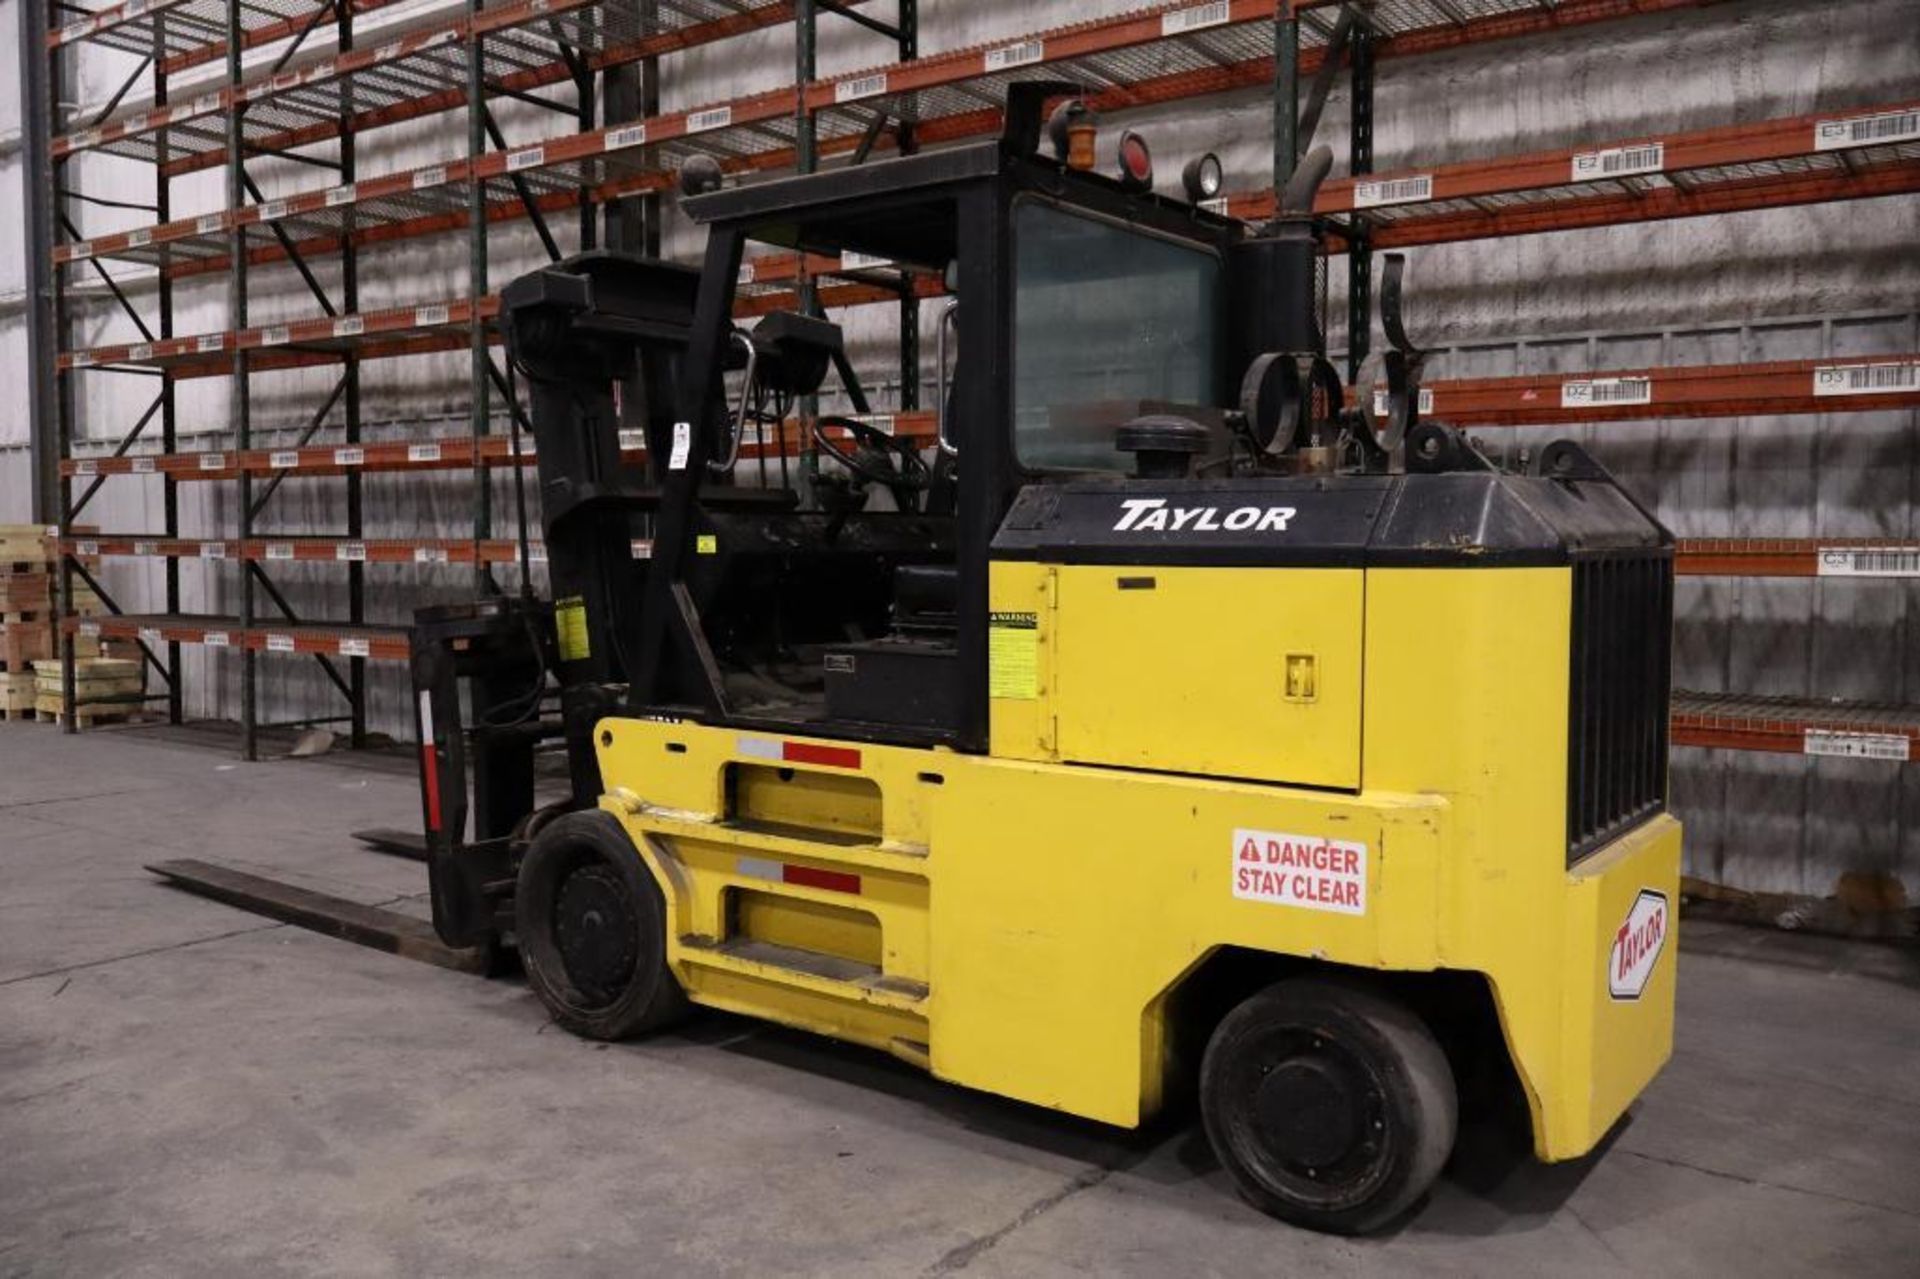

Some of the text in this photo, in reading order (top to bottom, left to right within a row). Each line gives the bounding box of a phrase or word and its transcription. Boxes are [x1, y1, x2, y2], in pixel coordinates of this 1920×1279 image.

[1822, 123, 1845, 137] E3
[1578, 157, 1597, 169] E2
[1113, 499, 1296, 531] TAYLOR
[1267, 840, 1359, 875] DANGER
[1238, 867, 1359, 907] STAY CLEAR
[1617, 907, 1662, 981] TAYLOR
